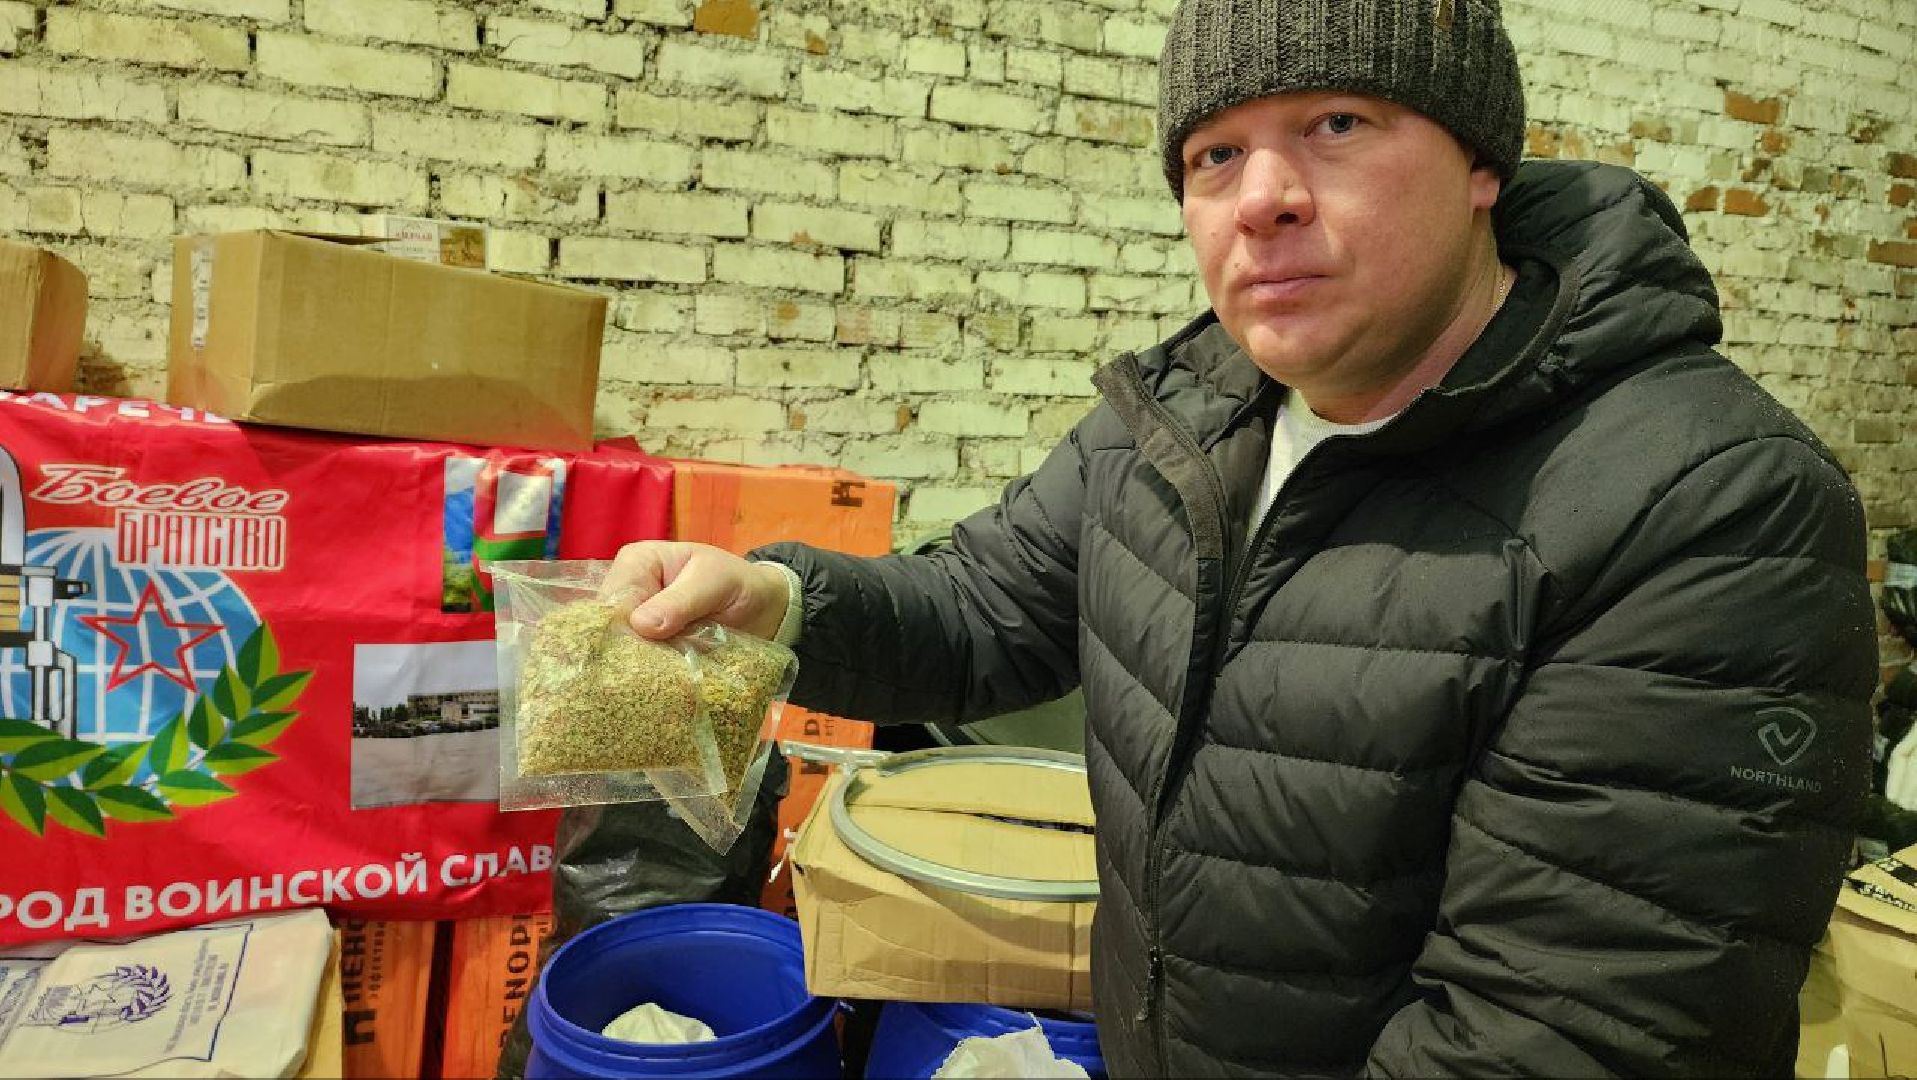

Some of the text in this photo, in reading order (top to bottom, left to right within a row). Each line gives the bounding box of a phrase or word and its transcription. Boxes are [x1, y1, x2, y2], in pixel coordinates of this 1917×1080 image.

[115, 509, 287, 571] БРАТСТВО
[1729, 765, 1822, 793] NORTHLAND
[124, 852, 428, 921] ВОИНСКОЙ
